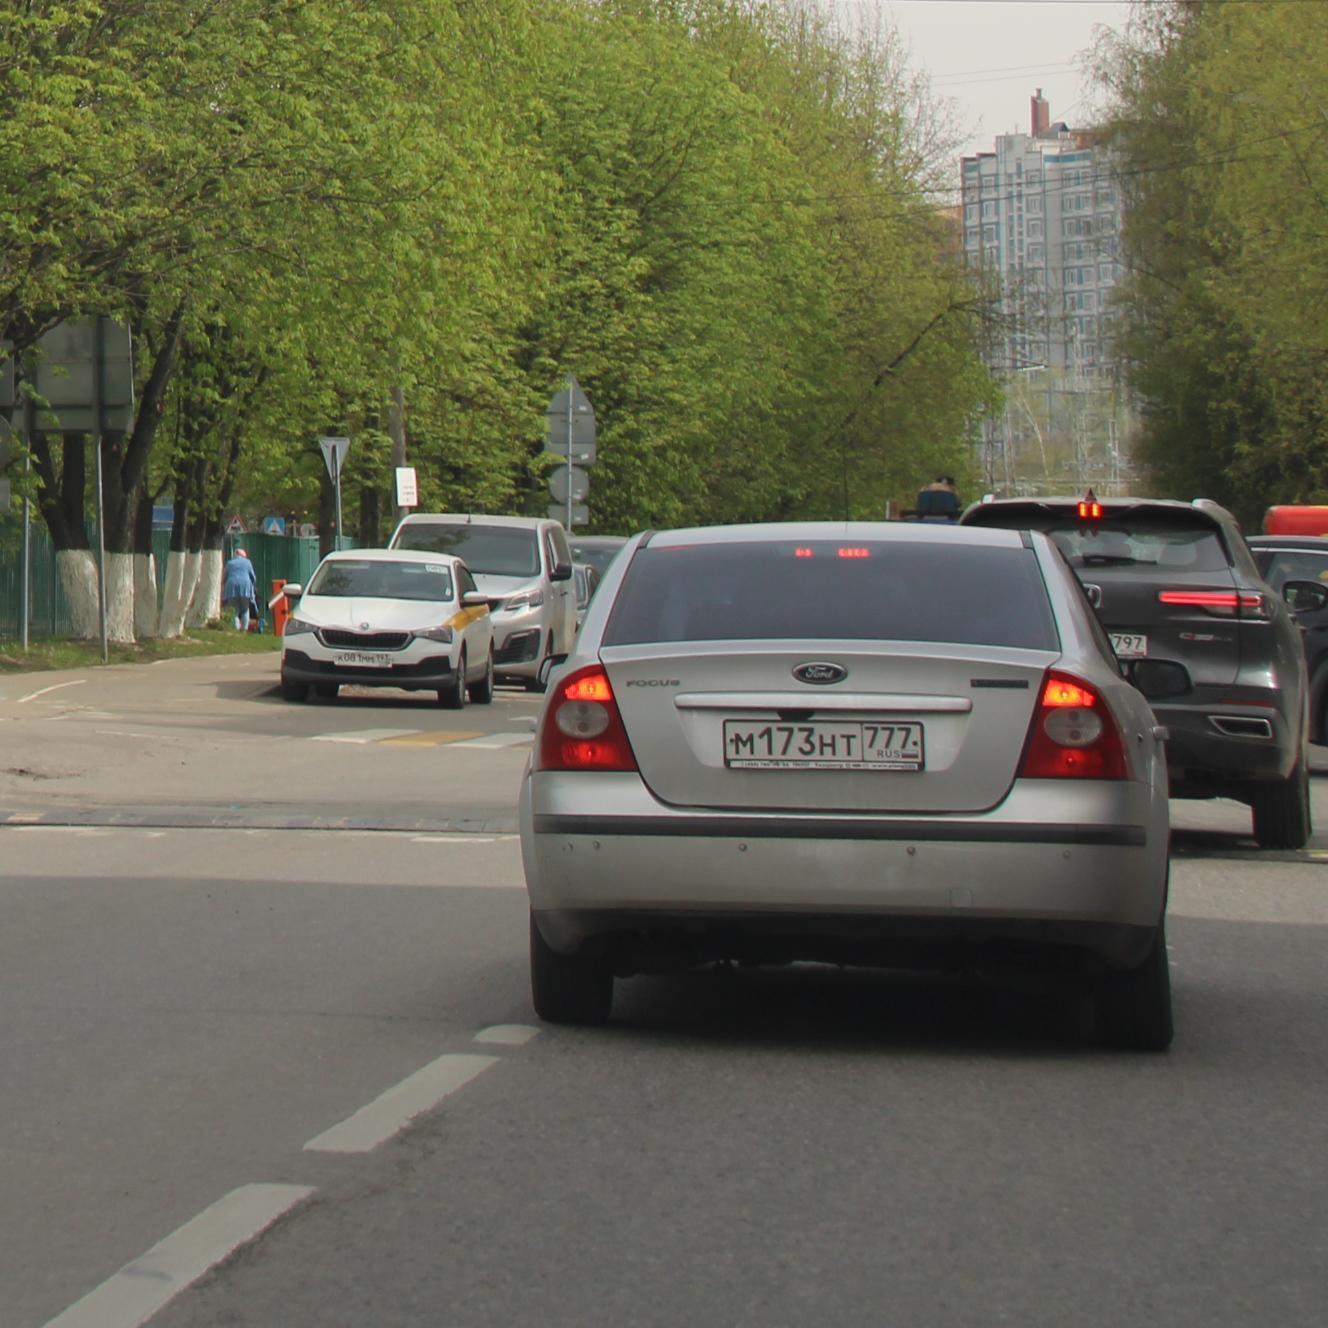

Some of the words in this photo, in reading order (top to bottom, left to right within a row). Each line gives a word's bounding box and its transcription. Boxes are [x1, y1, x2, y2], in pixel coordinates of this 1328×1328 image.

[1113, 635, 1142, 650] 797
[626, 679, 680, 688] FOCUS
[734, 726, 857, 756] М173НТ
[864, 726, 912, 750] 777
[877, 749, 901, 759] RUS
